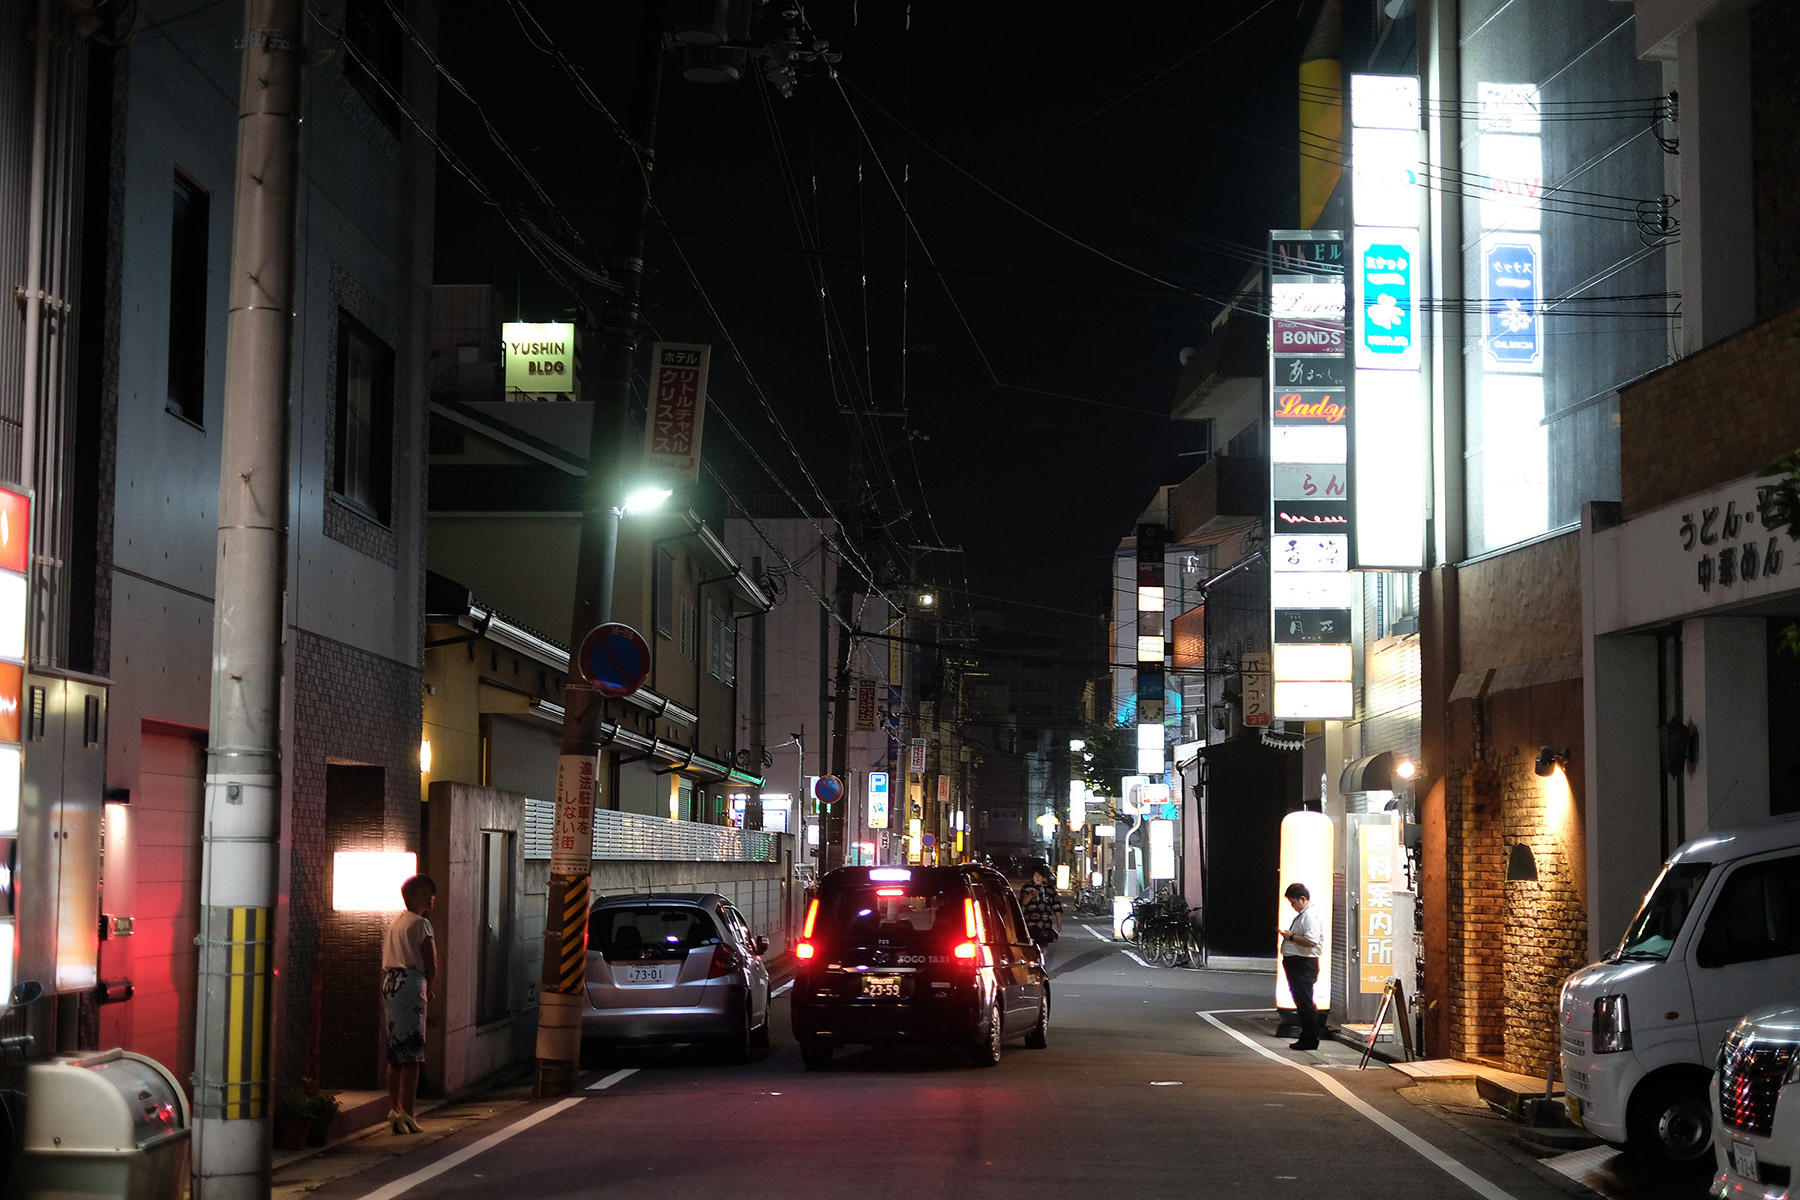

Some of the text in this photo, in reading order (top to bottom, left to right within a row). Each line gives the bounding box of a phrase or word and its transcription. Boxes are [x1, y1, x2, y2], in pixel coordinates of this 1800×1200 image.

[1282, 331, 1341, 345] BONDS
[511, 342, 565, 355] YUSHIN
[664, 352, 698, 364] ホテル
[528, 361, 565, 375] BLDG
[655, 370, 679, 453] クリスマス
[1303, 473, 1345, 496] らん
[871, 774, 886, 792] P
[577, 761, 593, 835] 違法駐車を
[560, 791, 577, 850] しない街
[1367, 829, 1393, 965] 料案内所
[928, 955, 950, 963] TAXI
[635, 969, 662, 980] 73-01
[870, 984, 900, 996] 23-59
